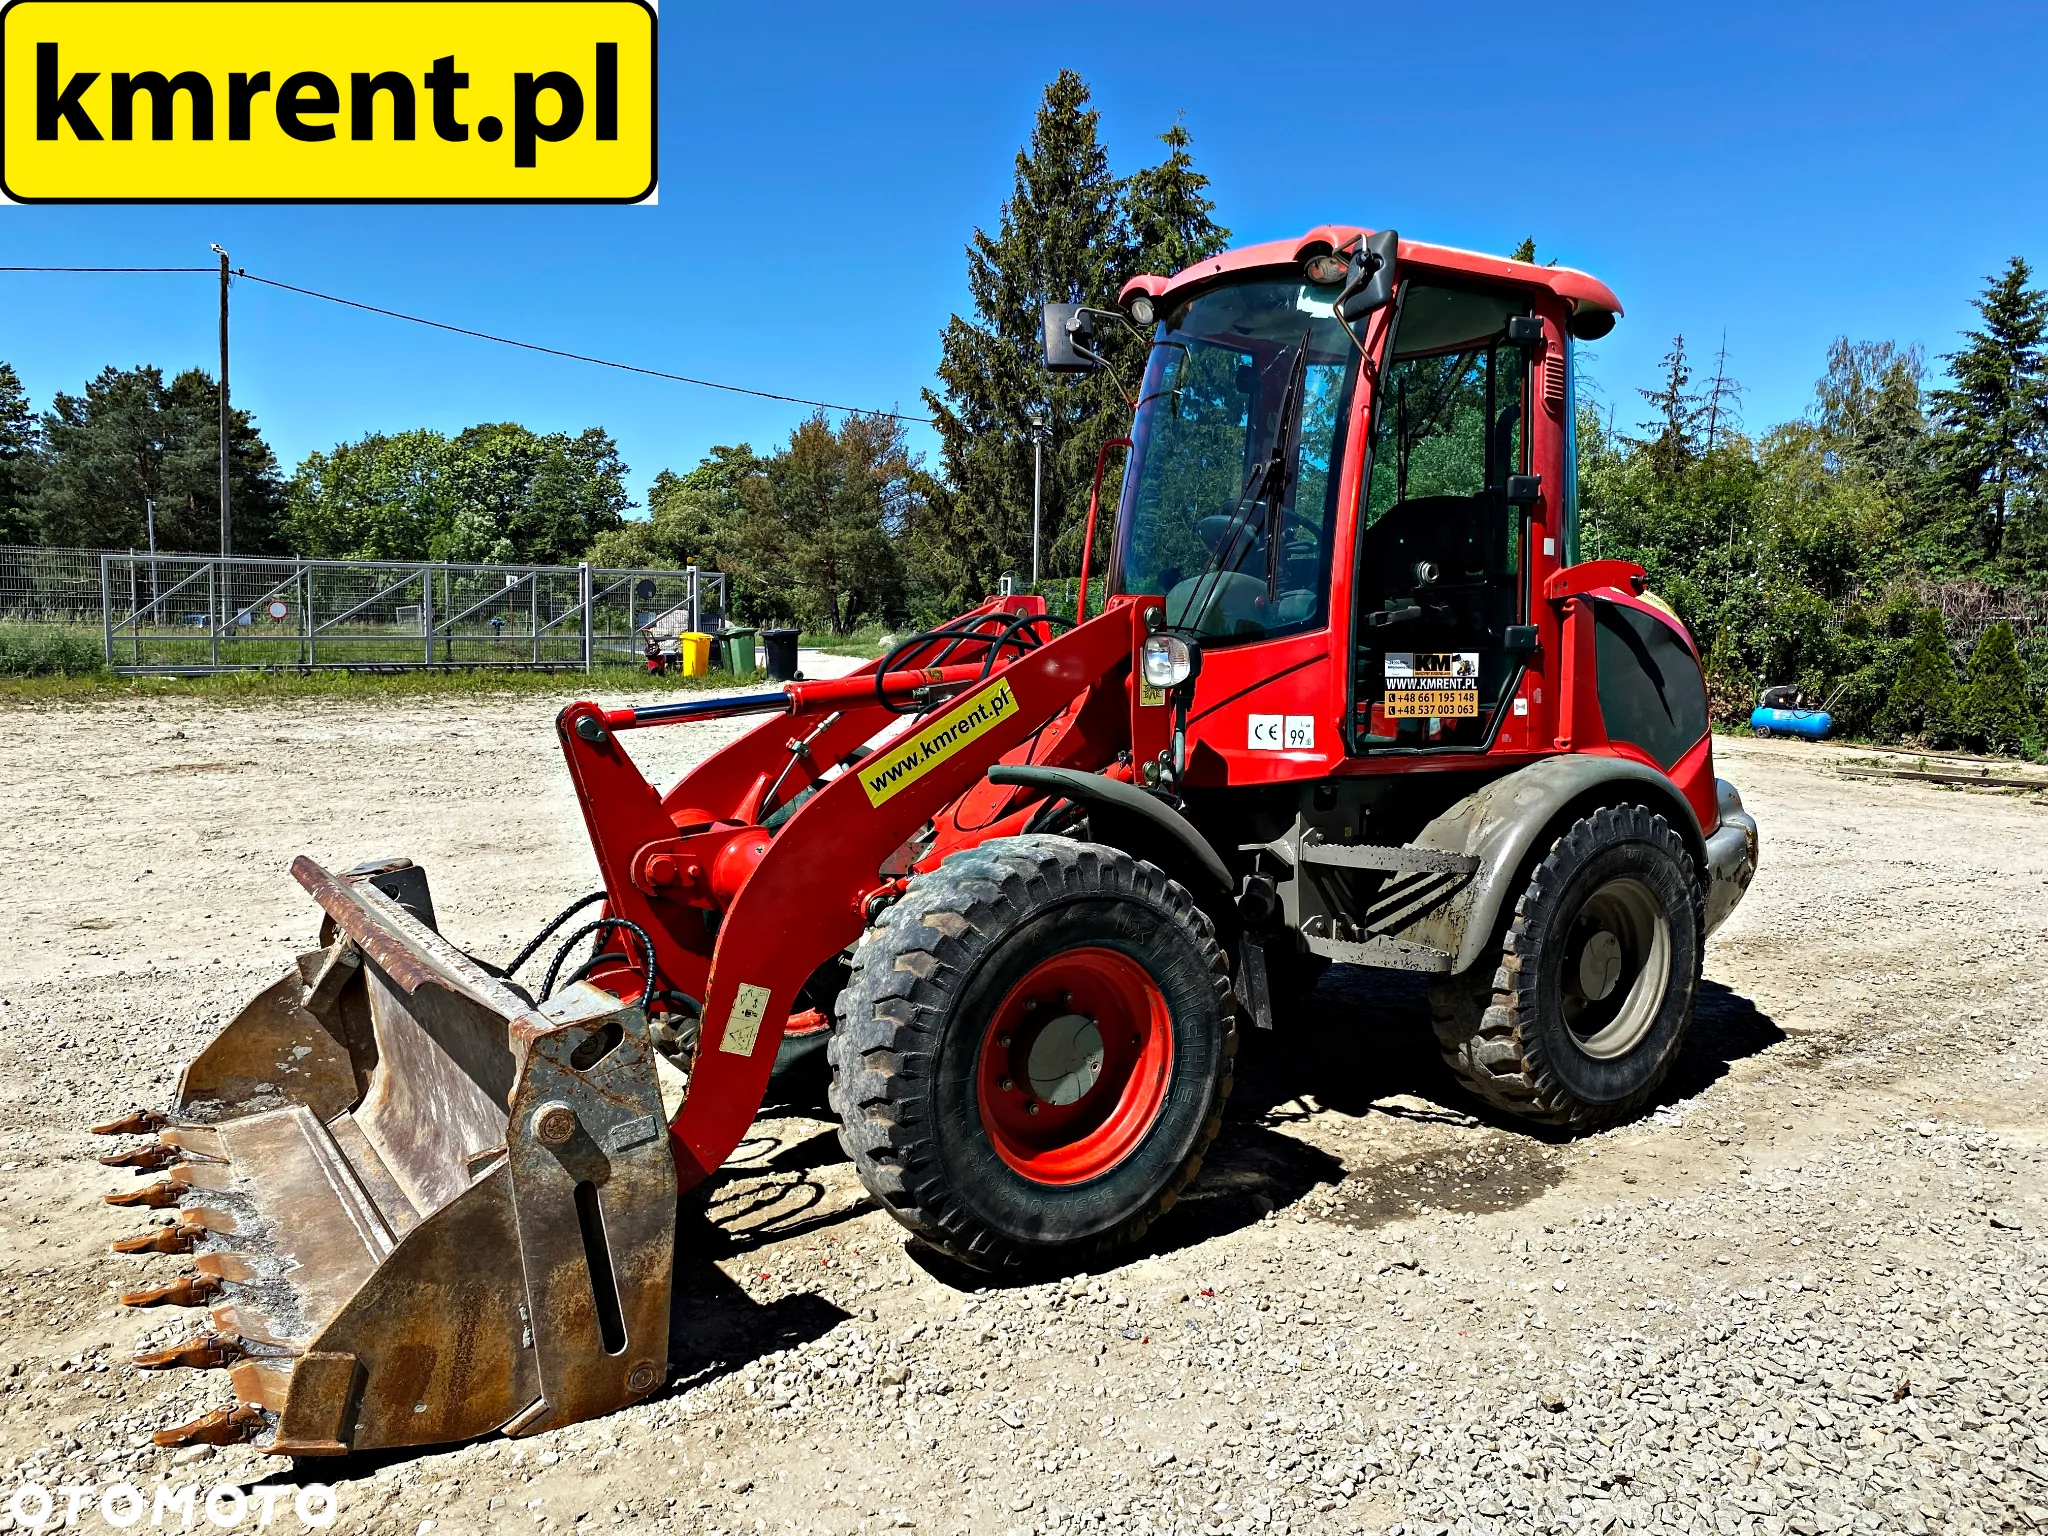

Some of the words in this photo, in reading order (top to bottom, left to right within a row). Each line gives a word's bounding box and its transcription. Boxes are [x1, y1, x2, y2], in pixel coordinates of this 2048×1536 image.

[1416, 655, 1451, 671] KM
[1386, 678, 1477, 690] WWW.KMRENT.PL
[1397, 693, 1415, 702] +48
[1418, 693, 1435, 702] 661
[1438, 693, 1455, 702] 195
[1458, 692, 1474, 702] 148
[1397, 706, 1415, 715] +48
[1418, 706, 1435, 714] 537
[1438, 705, 1455, 714] 003
[1457, 705, 1474, 714] 063
[869, 687, 1010, 792] www.kmrent.pl
[1255, 724, 1278, 741] CE
[1290, 729, 1305, 745] 99
[1136, 957, 1206, 1180] MICHELIN
